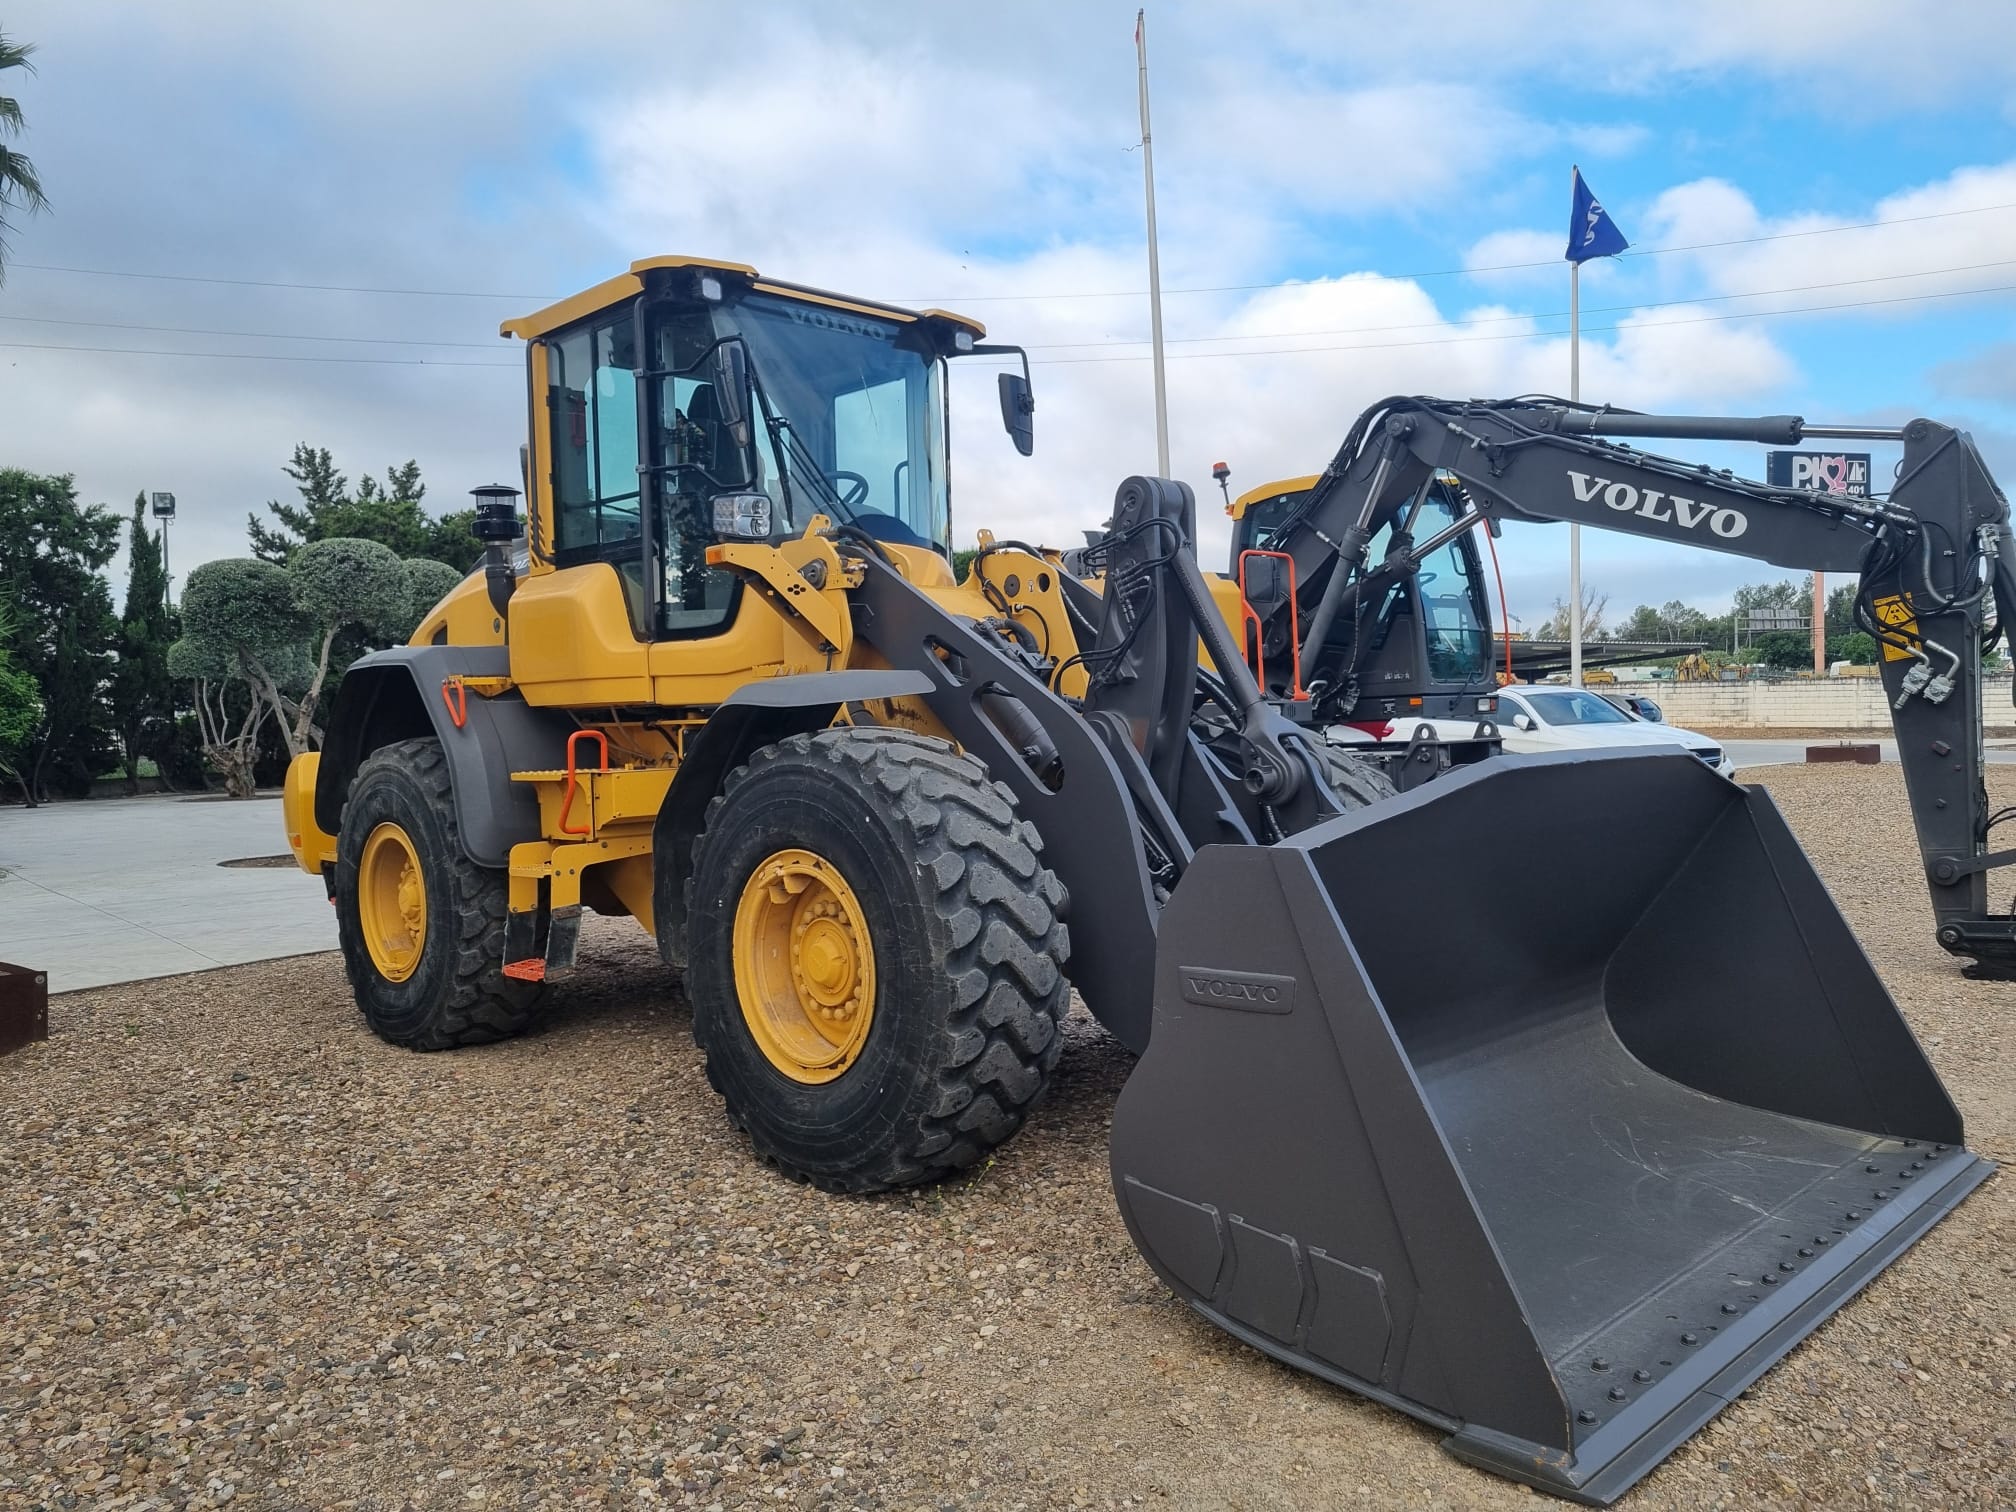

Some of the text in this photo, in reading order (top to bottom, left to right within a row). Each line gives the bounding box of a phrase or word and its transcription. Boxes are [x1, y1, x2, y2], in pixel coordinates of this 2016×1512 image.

[782, 306, 885, 341] VOLVO
[1567, 470, 1748, 538] VOLVO
[1847, 485, 1865, 495] 401
[1188, 977, 1280, 1003] VOLVO
